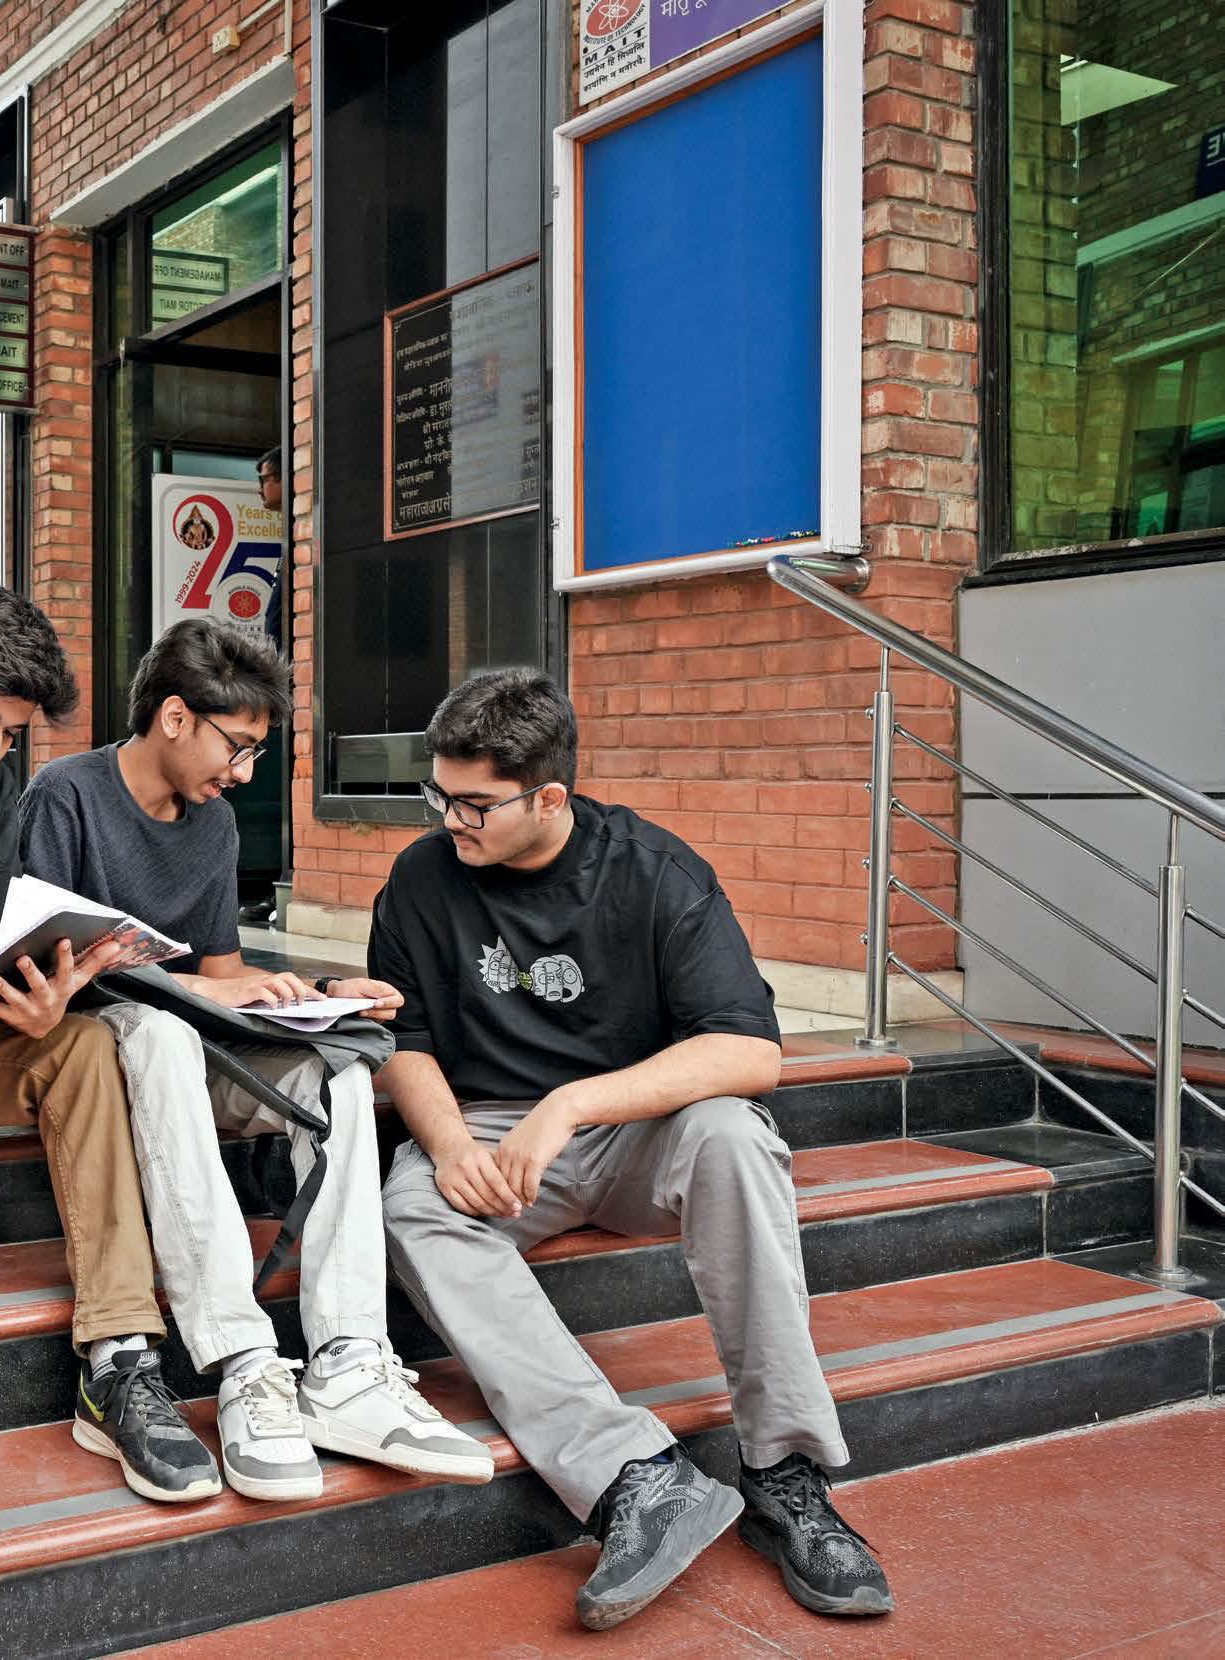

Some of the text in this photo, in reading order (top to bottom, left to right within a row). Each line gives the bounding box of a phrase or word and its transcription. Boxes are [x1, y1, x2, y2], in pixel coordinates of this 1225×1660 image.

[9, 244, 25, 257] OFF
[0, 277, 19, 290] MAIT
[236, 503, 271, 520] Years
[238, 521, 286, 537] Excelle
[175, 560, 201, 604] 1999-2024
